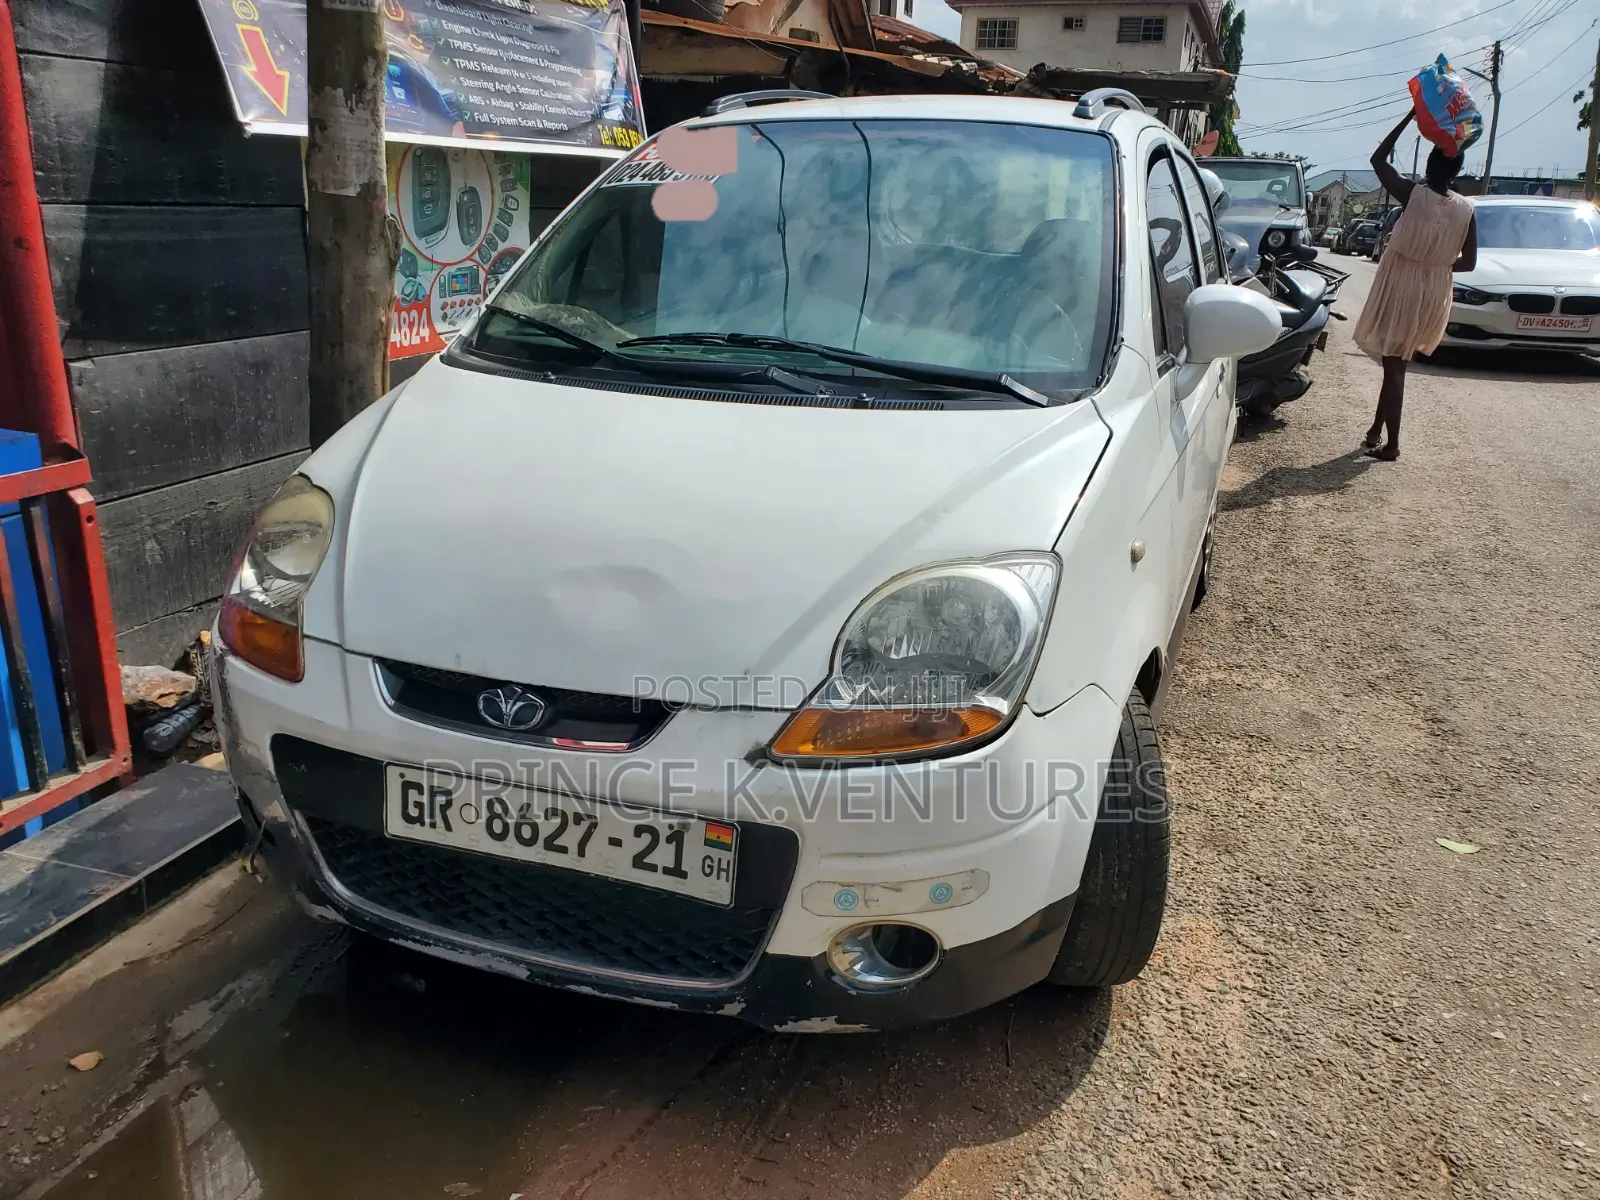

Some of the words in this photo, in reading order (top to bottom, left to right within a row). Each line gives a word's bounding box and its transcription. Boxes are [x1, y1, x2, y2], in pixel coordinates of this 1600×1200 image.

[436, 1, 481, 20] Dashboard
[482, 14, 504, 26] Light
[441, 20, 472, 35] Engine
[472, 26, 496, 40] Check
[497, 32, 514, 45] Light
[514, 37, 544, 51] Diagnosis
[544, 44, 551, 52] &
[550, 45, 561, 56] Fix
[448, 38, 473, 52] TPMS
[474, 44, 498, 57] Sensor
[498, 49, 539, 67] Replacement
[539, 59, 545, 67] &
[453, 58, 481, 72] TPMS
[482, 61, 512, 76] Relearn
[530, 73, 555, 86] including
[459, 77, 495, 92] Steering
[495, 82, 517, 94] Angle
[517, 85, 540, 97] Sensor
[540, 88, 573, 102] Calibration
[469, 95, 485, 106] ABS
[491, 99, 515, 111] Airbag
[520, 101, 545, 115] Stability
[545, 105, 567, 116] Control
[474, 112, 490, 123] Full
[491, 114, 518, 127] System
[519, 117, 537, 128] Scan
[537, 120, 544, 128] &
[543, 120, 568, 131] Reports
[597, 124, 614, 146] Tel:
[613, 127, 631, 148] 053
[607, 162, 650, 185] 024
[389, 309, 430, 347] 4824
[400, 778, 454, 833] GR
[701, 853, 731, 883] GH
